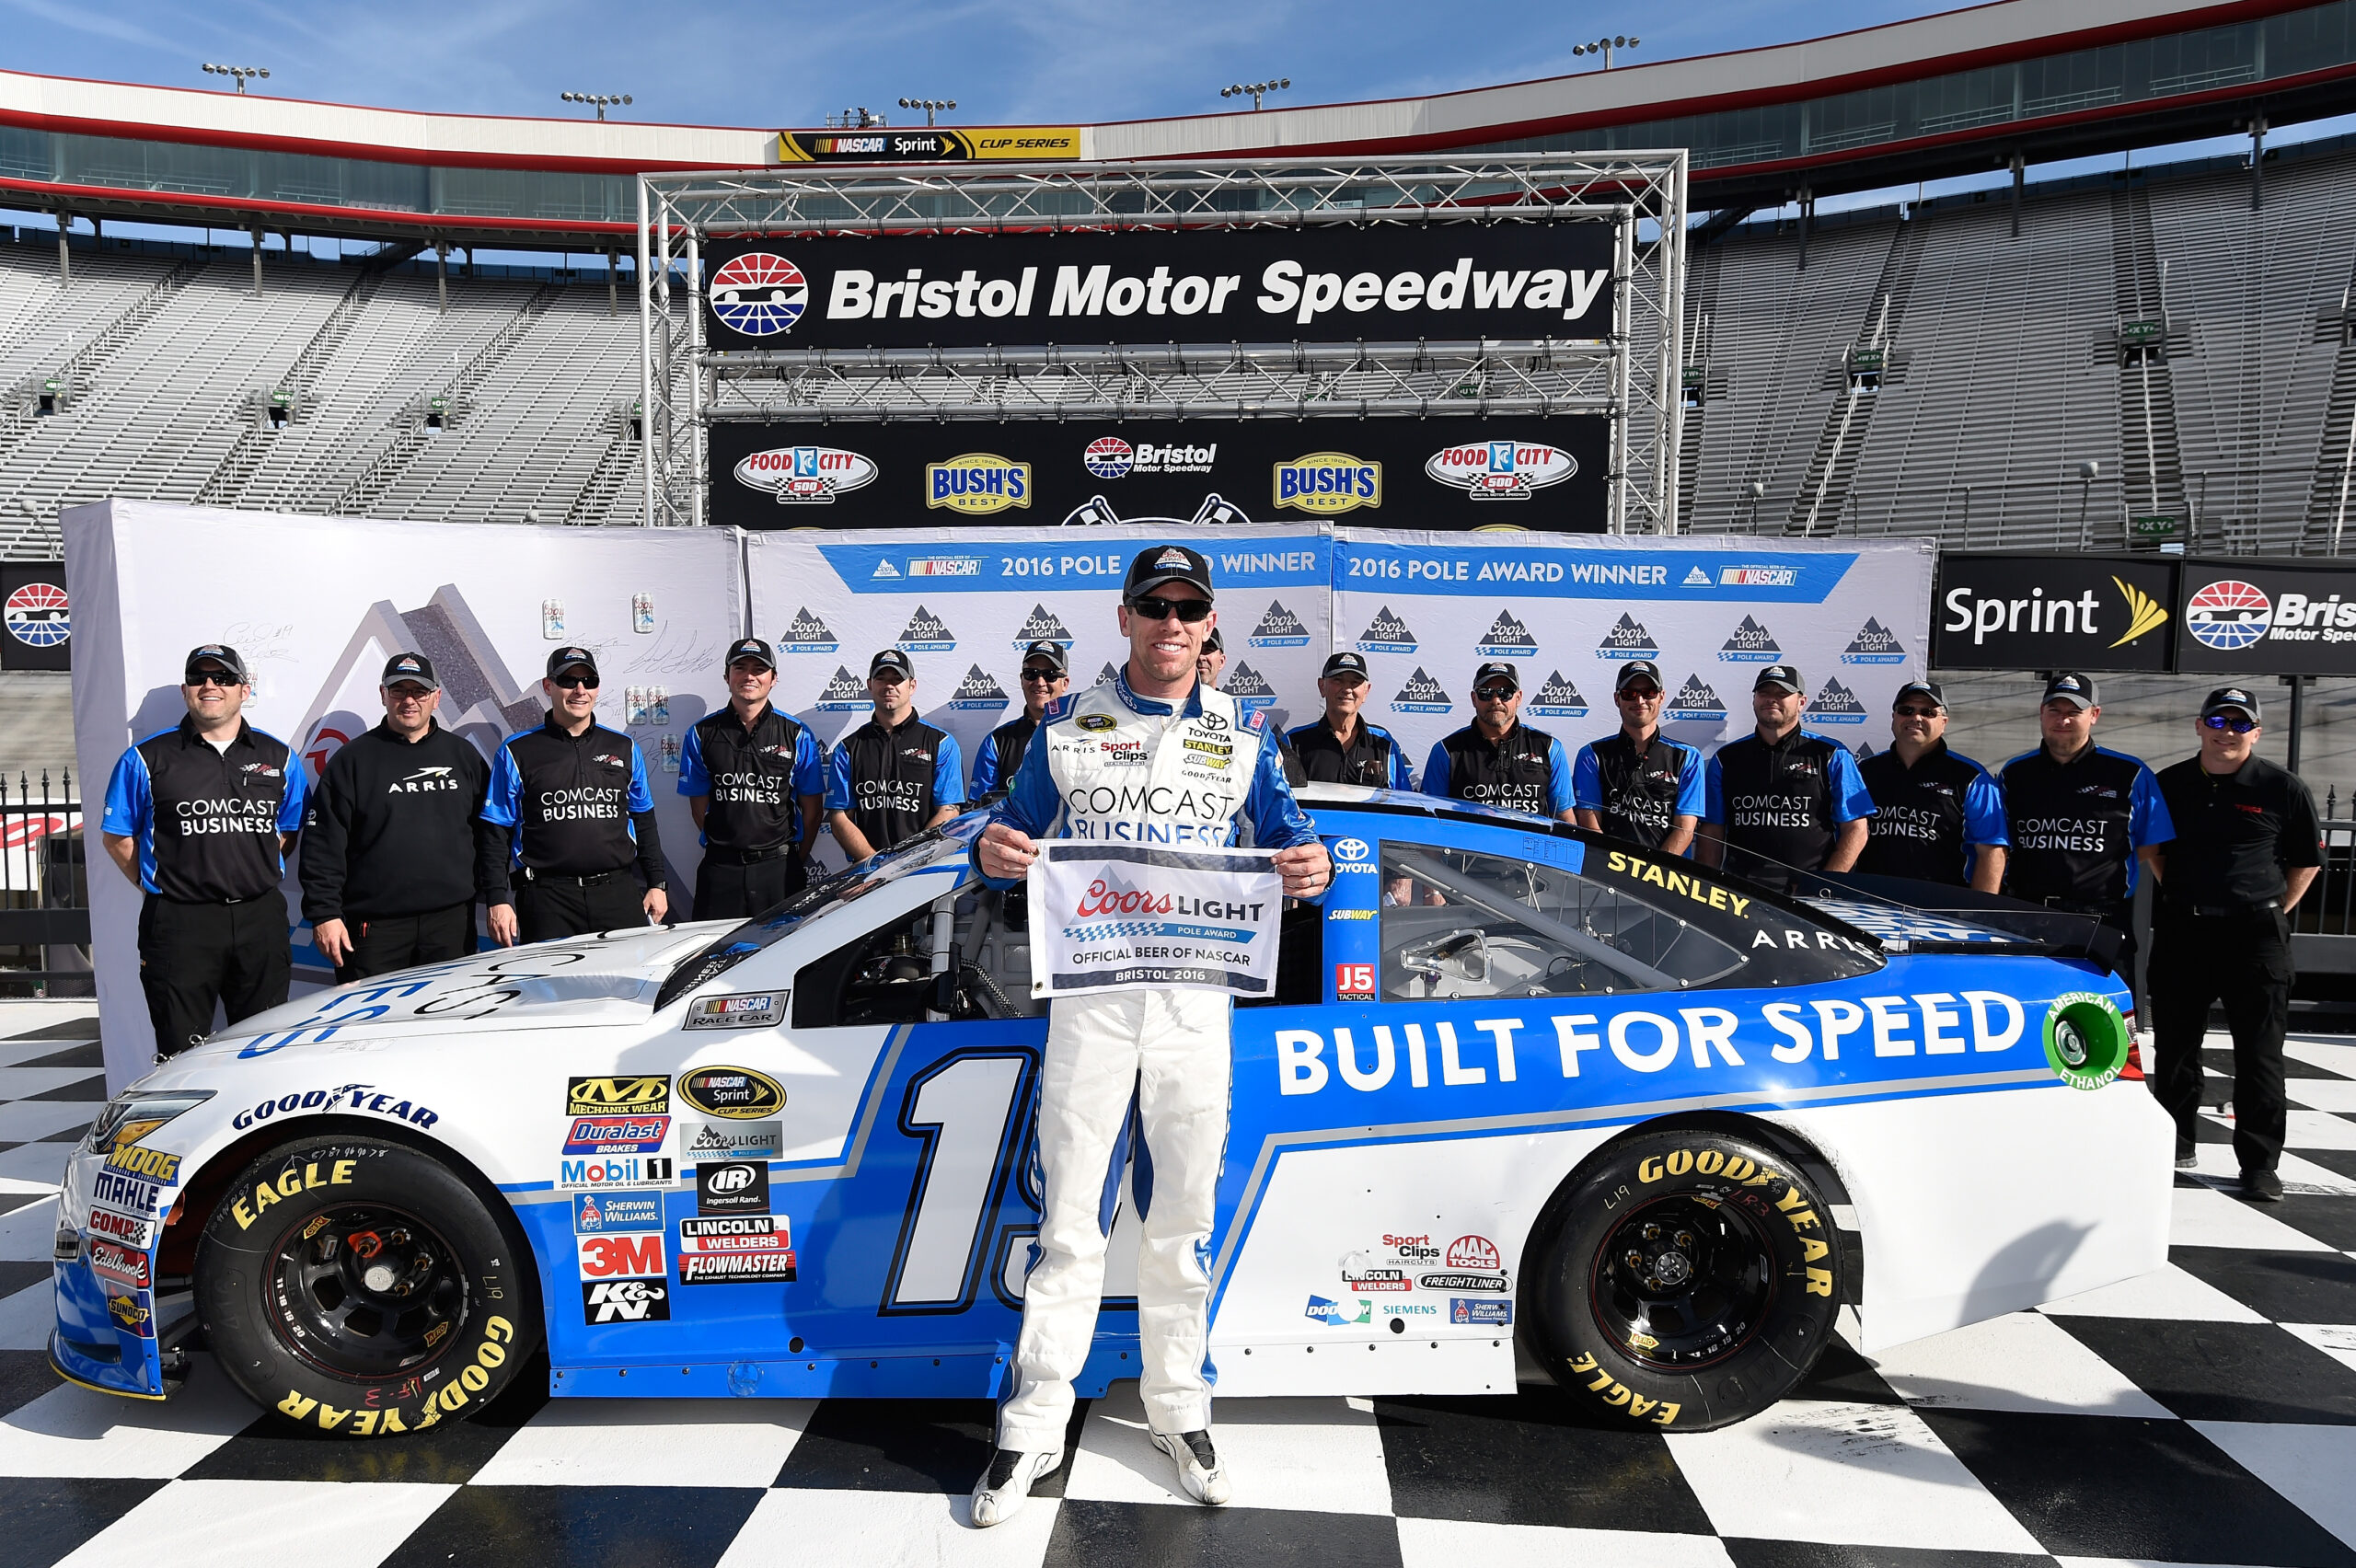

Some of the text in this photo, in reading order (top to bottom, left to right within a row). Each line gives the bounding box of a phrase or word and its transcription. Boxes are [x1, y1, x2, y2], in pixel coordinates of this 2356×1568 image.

[837, 137, 1070, 155] NASCAR Sprint CUP SERIES
[826, 258, 1609, 325] Bristol Motor Speedway
[749, 454, 855, 470] FOOD CITY
[1135, 444, 1217, 464] Bristol
[1442, 448, 1554, 466] FOOD CITY
[1133, 464, 1212, 474] Motor Speedway
[792, 481, 818, 491] 500
[932, 467, 1026, 500] BUSH'S
[1280, 467, 1375, 500] BUSH'S
[1487, 478, 1514, 488] 500
[931, 560, 979, 575] NASCAR
[1001, 555, 1122, 576] 2016 POLE
[1221, 552, 1316, 573] WINNER
[1348, 557, 1401, 579] 2016
[1408, 561, 1470, 582] POLE
[1476, 562, 1563, 582] AWARD
[1571, 564, 1668, 585] WINNER
[1747, 570, 1796, 585] NASCAR
[1945, 587, 2100, 645] Sprint
[2272, 594, 2356, 628] Bris
[788, 617, 829, 632] Coors
[1369, 617, 1410, 634] Coors
[795, 631, 822, 640] LIGHT
[1375, 631, 1402, 640] LIGHT
[1852, 628, 1897, 644] Coors
[2269, 628, 2356, 643] Motor Spee
[1860, 641, 1888, 651] LIGHT
[1815, 687, 1858, 704] Coors
[1821, 701, 1850, 711] LIGHT
[1188, 727, 1231, 743] TOYOTA
[1050, 744, 1096, 754] ARRIS
[1101, 741, 1141, 753] Sport
[1184, 740, 1231, 755] STANLEY
[1112, 751, 1148, 762] Clips
[1184, 754, 1231, 769] SUBWAY
[388, 779, 458, 794] ARRIS
[714, 772, 782, 790] COMCAST
[856, 779, 923, 797] COMCAST
[540, 787, 621, 806] COMCAST
[1463, 784, 1541, 799] COMCAST
[176, 798, 277, 817] COMCAST
[1069, 785, 1234, 822] COMCAST
[1610, 788, 1672, 814] CMCAST
[1732, 795, 1812, 811] COMCAST
[543, 804, 618, 823] BUSINESS
[1734, 812, 1810, 827] BUSINESS
[1871, 805, 1941, 827] OMCAST
[180, 816, 272, 836] BUSINESS
[1868, 822, 1937, 841] USINESS
[2017, 818, 2108, 835] COMCAST
[2018, 836, 2106, 852] BUSINESS
[1335, 863, 1378, 874] OYOTA
[1076, 879, 1265, 922] Coors LIGHT
[1328, 909, 1379, 921] SUBWAY
[1177, 927, 1237, 940] POLE AWARD
[1751, 929, 1876, 957] ARRIS
[1072, 946, 1251, 966] OFFICIAL BEER OF NASCAR
[1115, 969, 1206, 982] BRISTOL 2016
[1339, 966, 1373, 991] J5
[724, 997, 770, 1012] NASCAR
[1337, 993, 1374, 1001] TACTICAL
[2047, 991, 2117, 1021] AMERICAN
[692, 1014, 772, 1025] RACE CAR
[1276, 990, 2026, 1096] BUILT FOR SPEED
[708, 1077, 747, 1088] NASCAR
[2059, 1066, 2122, 1090] ETHANOL
[713, 1090, 751, 1104] Sprint
[232, 1084, 439, 1130] GOODYEAR
[569, 1101, 667, 1115] MECHANIX WEAR
[574, 1120, 662, 1141] Duralast
[696, 1132, 777, 1147] Coors LIGHT
[595, 1145, 639, 1153] BRAKES
[106, 1143, 180, 1181] MOOG
[561, 1159, 639, 1183] Mobil
[716, 1170, 748, 1190] IR
[94, 1171, 160, 1213] MAHLE
[231, 1159, 357, 1230] EAGLE
[706, 1196, 738, 1205] Ingersoll
[605, 1201, 655, 1212] SHERWIN
[89, 1210, 135, 1237] COMP
[304, 1216, 331, 1239] AERO
[686, 1219, 770, 1236] LINCOLN
[1638, 1149, 1831, 1297] GOODYEAR
[705, 1236, 780, 1249] WELDERS
[1382, 1234, 1429, 1248] Sport
[1449, 1239, 1496, 1258] MAC
[583, 1236, 663, 1276] 3M
[1398, 1246, 1440, 1259] Clips
[93, 1246, 147, 1280] Edelbrock
[686, 1254, 788, 1281] FLOWMASTER
[1449, 1258, 1497, 1268] TOOLS
[1357, 1282, 1406, 1290] WELDERS
[1424, 1276, 1503, 1289] FREIGHTLINER
[110, 1299, 146, 1320] SUNOCO
[1307, 1303, 1370, 1316] DOON
[1383, 1305, 1437, 1315] SIEMENS
[427, 1321, 449, 1346] AERO
[1633, 1333, 1654, 1346] AERO
[277, 1315, 514, 1435] GOODYEAR
[1566, 1351, 1681, 1424] EAGLE
